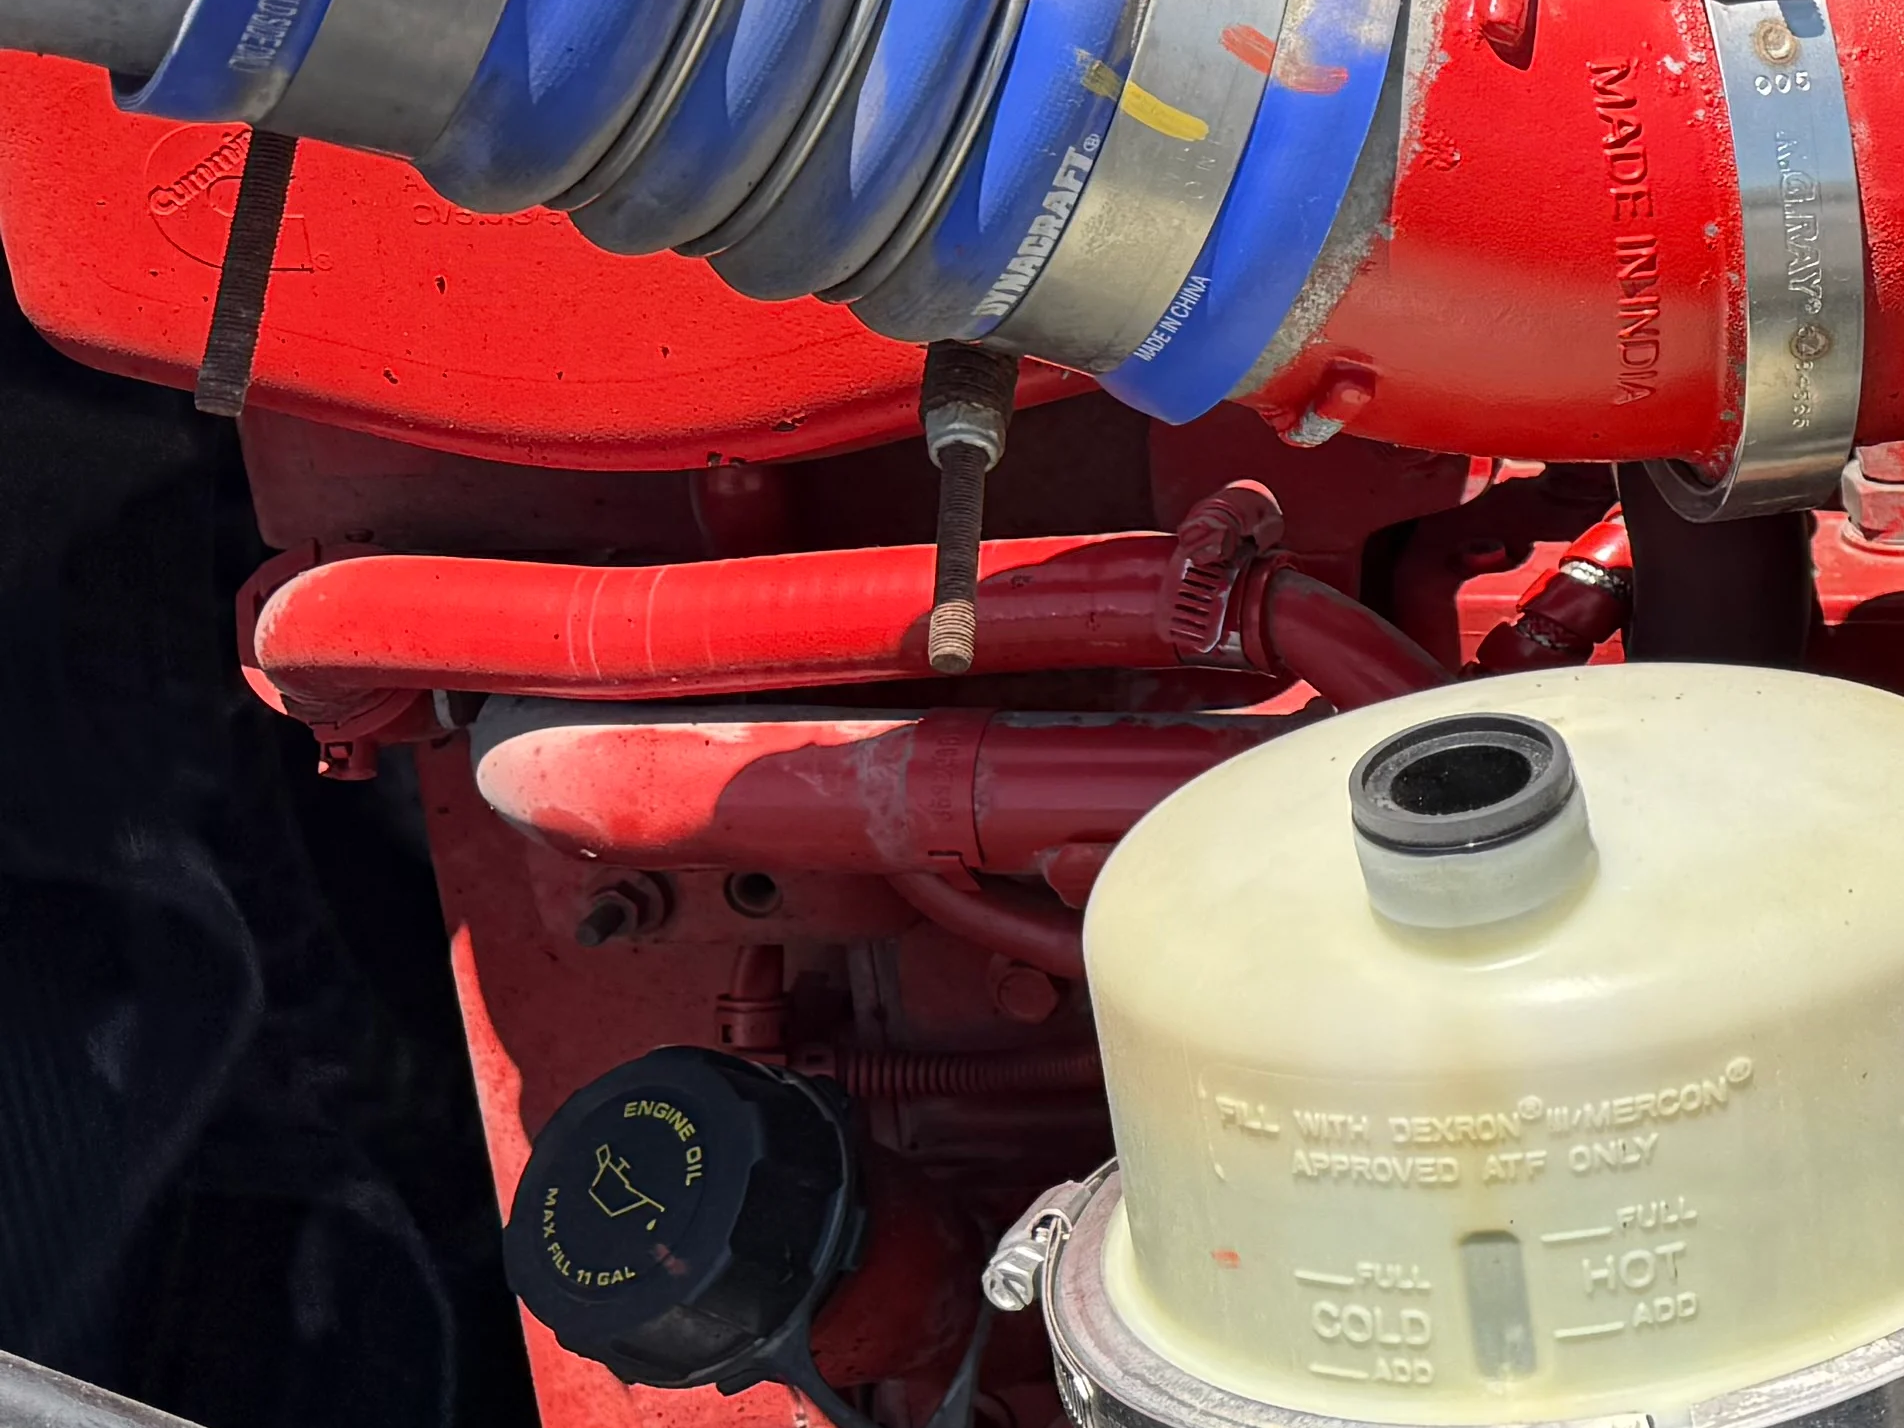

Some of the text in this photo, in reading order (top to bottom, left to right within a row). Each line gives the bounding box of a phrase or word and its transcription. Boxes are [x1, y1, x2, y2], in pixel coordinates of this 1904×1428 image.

[1586, 56, 1661, 407] MADE IN INDIA
[1133, 328, 1174, 363] MADE
[1170, 274, 1213, 320] CHINA
[623, 1099, 703, 1187] ENGINE OIL
[1214, 1092, 1281, 1134] FILL
[1293, 1107, 1370, 1146] WITH
[1290, 1132, 1661, 1187] APPROVED ATF ONLY
[542, 1187, 636, 1287] MAX FILL 11 GAL
[1616, 1195, 1699, 1230] FULL
[1355, 1260, 1432, 1291] FULL
[1581, 1239, 1687, 1296] HOT
[1310, 1298, 1432, 1348] COLD
[1632, 1289, 1699, 1329] ADD
[1372, 1356, 1435, 1385] ADD
